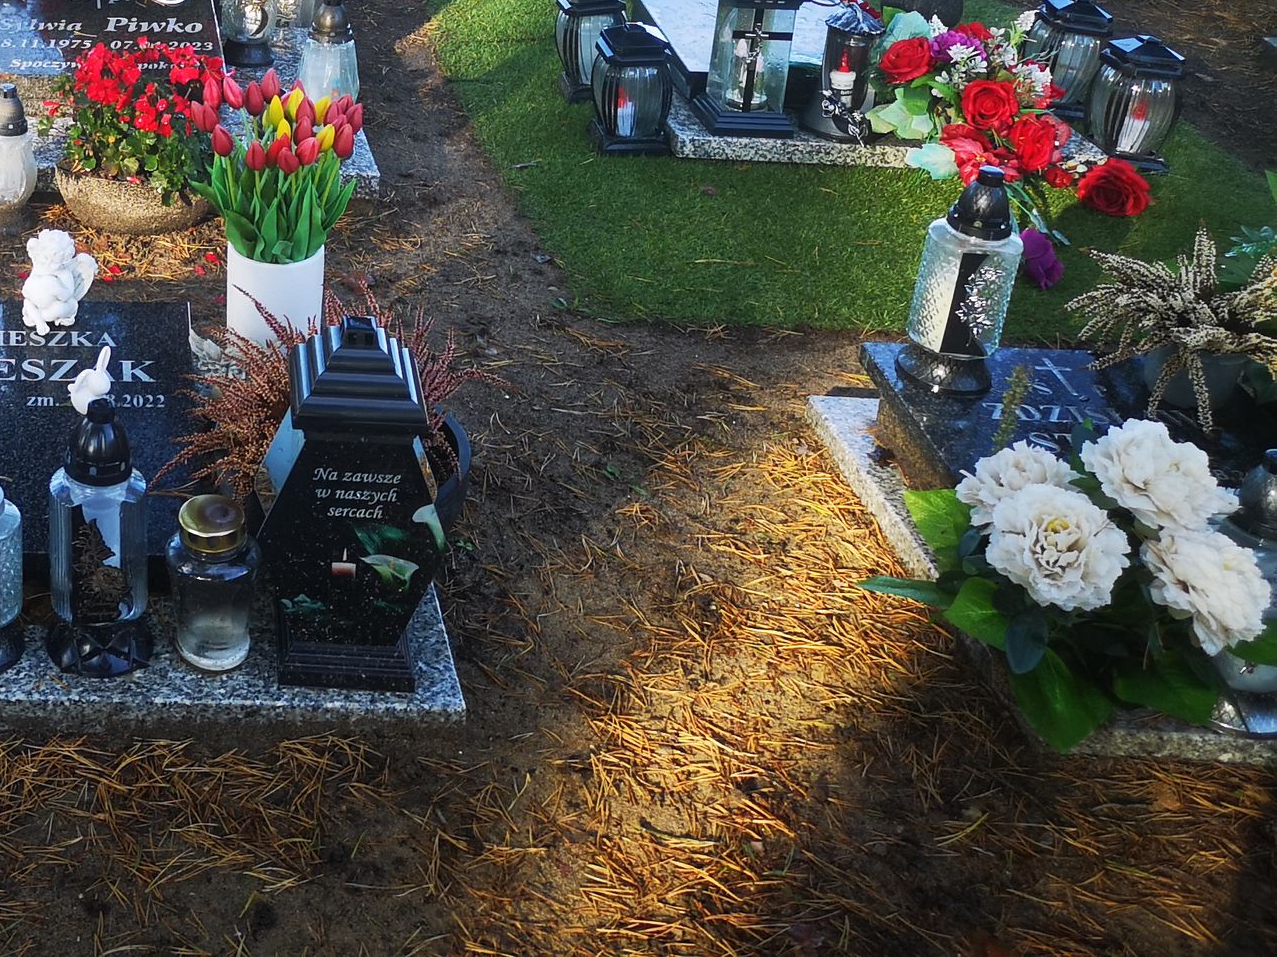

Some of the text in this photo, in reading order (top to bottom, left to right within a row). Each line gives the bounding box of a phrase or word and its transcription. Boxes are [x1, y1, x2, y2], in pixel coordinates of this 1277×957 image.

[104, 17, 203, 33] Piwko
[26, 395, 60, 407] zm.
[312, 467, 402, 484] Na zawsze
[315, 488, 398, 505] w naszych
[327, 505, 383, 519] sercach
